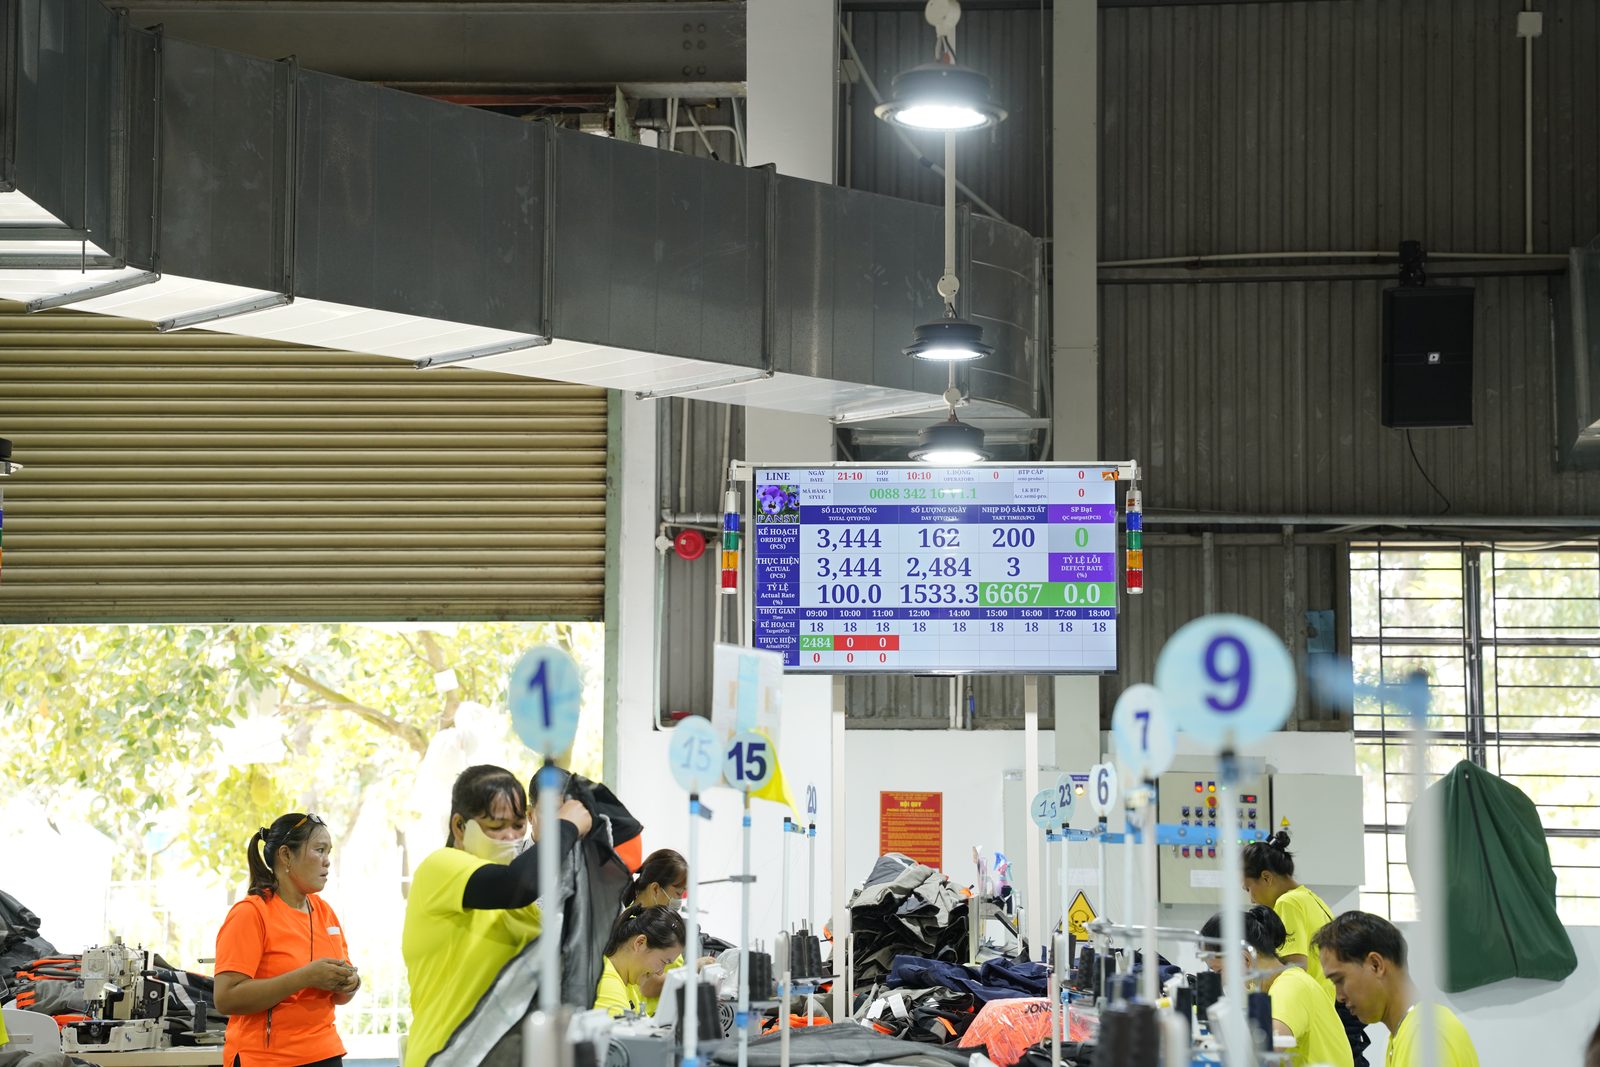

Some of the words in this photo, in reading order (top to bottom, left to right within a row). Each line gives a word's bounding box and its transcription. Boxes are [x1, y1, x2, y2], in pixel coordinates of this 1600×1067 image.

[766, 473, 790, 481] LINE
[837, 472, 862, 481] 21-10
[907, 472, 931, 480] 10:10
[993, 472, 999, 480] 0
[1078, 470, 1085, 480] 0
[870, 488, 900, 499] 0088
[903, 488, 927, 499] 342
[1079, 488, 1085, 497] 0
[821, 506, 831, 514] SỐ
[832, 506, 857, 514] LƯỢNG
[858, 505, 878, 514] TỔNG
[921, 506, 947, 514] LƯỢNG
[982, 506, 999, 514] NHỊP
[1000, 506, 1011, 514] ĐỘ
[757, 514, 799, 523] PANSY
[758, 527, 769, 536] KẾ
[770, 528, 798, 537] HOẠCH
[992, 527, 1036, 548] 200
[1075, 527, 1089, 548] 0
[816, 528, 882, 552] 3,444
[918, 528, 960, 548] 162
[756, 557, 779, 566] THỰC
[779, 556, 800, 566] HIỆN
[1062, 556, 1074, 564] TỶ
[1075, 555, 1086, 565] LỆ
[816, 557, 882, 581] 3,444
[906, 557, 972, 581] 2,484
[1007, 557, 1021, 577] 3
[766, 583, 777, 591] TỶ
[778, 583, 789, 592] LỆ
[817, 584, 882, 604] 100.0
[900, 584, 979, 604] 1533.3
[985, 583, 1043, 604] 6667
[1063, 583, 1100, 604] 0.0
[760, 620, 770, 628] KẾ
[771, 621, 795, 629] HOẠCH
[810, 622, 824, 633] 18
[843, 622, 858, 633] 18
[876, 622, 890, 633] 18
[912, 622, 927, 633] 18
[952, 622, 967, 633] 18
[990, 622, 1004, 633] 18
[1024, 622, 1039, 633] 18
[1058, 622, 1073, 633] 18
[1092, 622, 1107, 633] 18
[779, 636, 797, 644] HIỆN
[802, 637, 831, 648] 2484
[846, 637, 854, 648] 0
[879, 637, 887, 648] 0
[813, 652, 821, 663] 0
[847, 652, 854, 663] 0
[879, 652, 887, 663] 0
[1204, 634, 1252, 712] 9
[529, 658, 553, 728] 1
[1134, 711, 1151, 751] 7
[681, 736, 712, 772] 15
[727, 741, 767, 781] 15
[1097, 768, 1109, 805] 6
[806, 785, 817, 814] 20
[1059, 783, 1072, 808] 23
